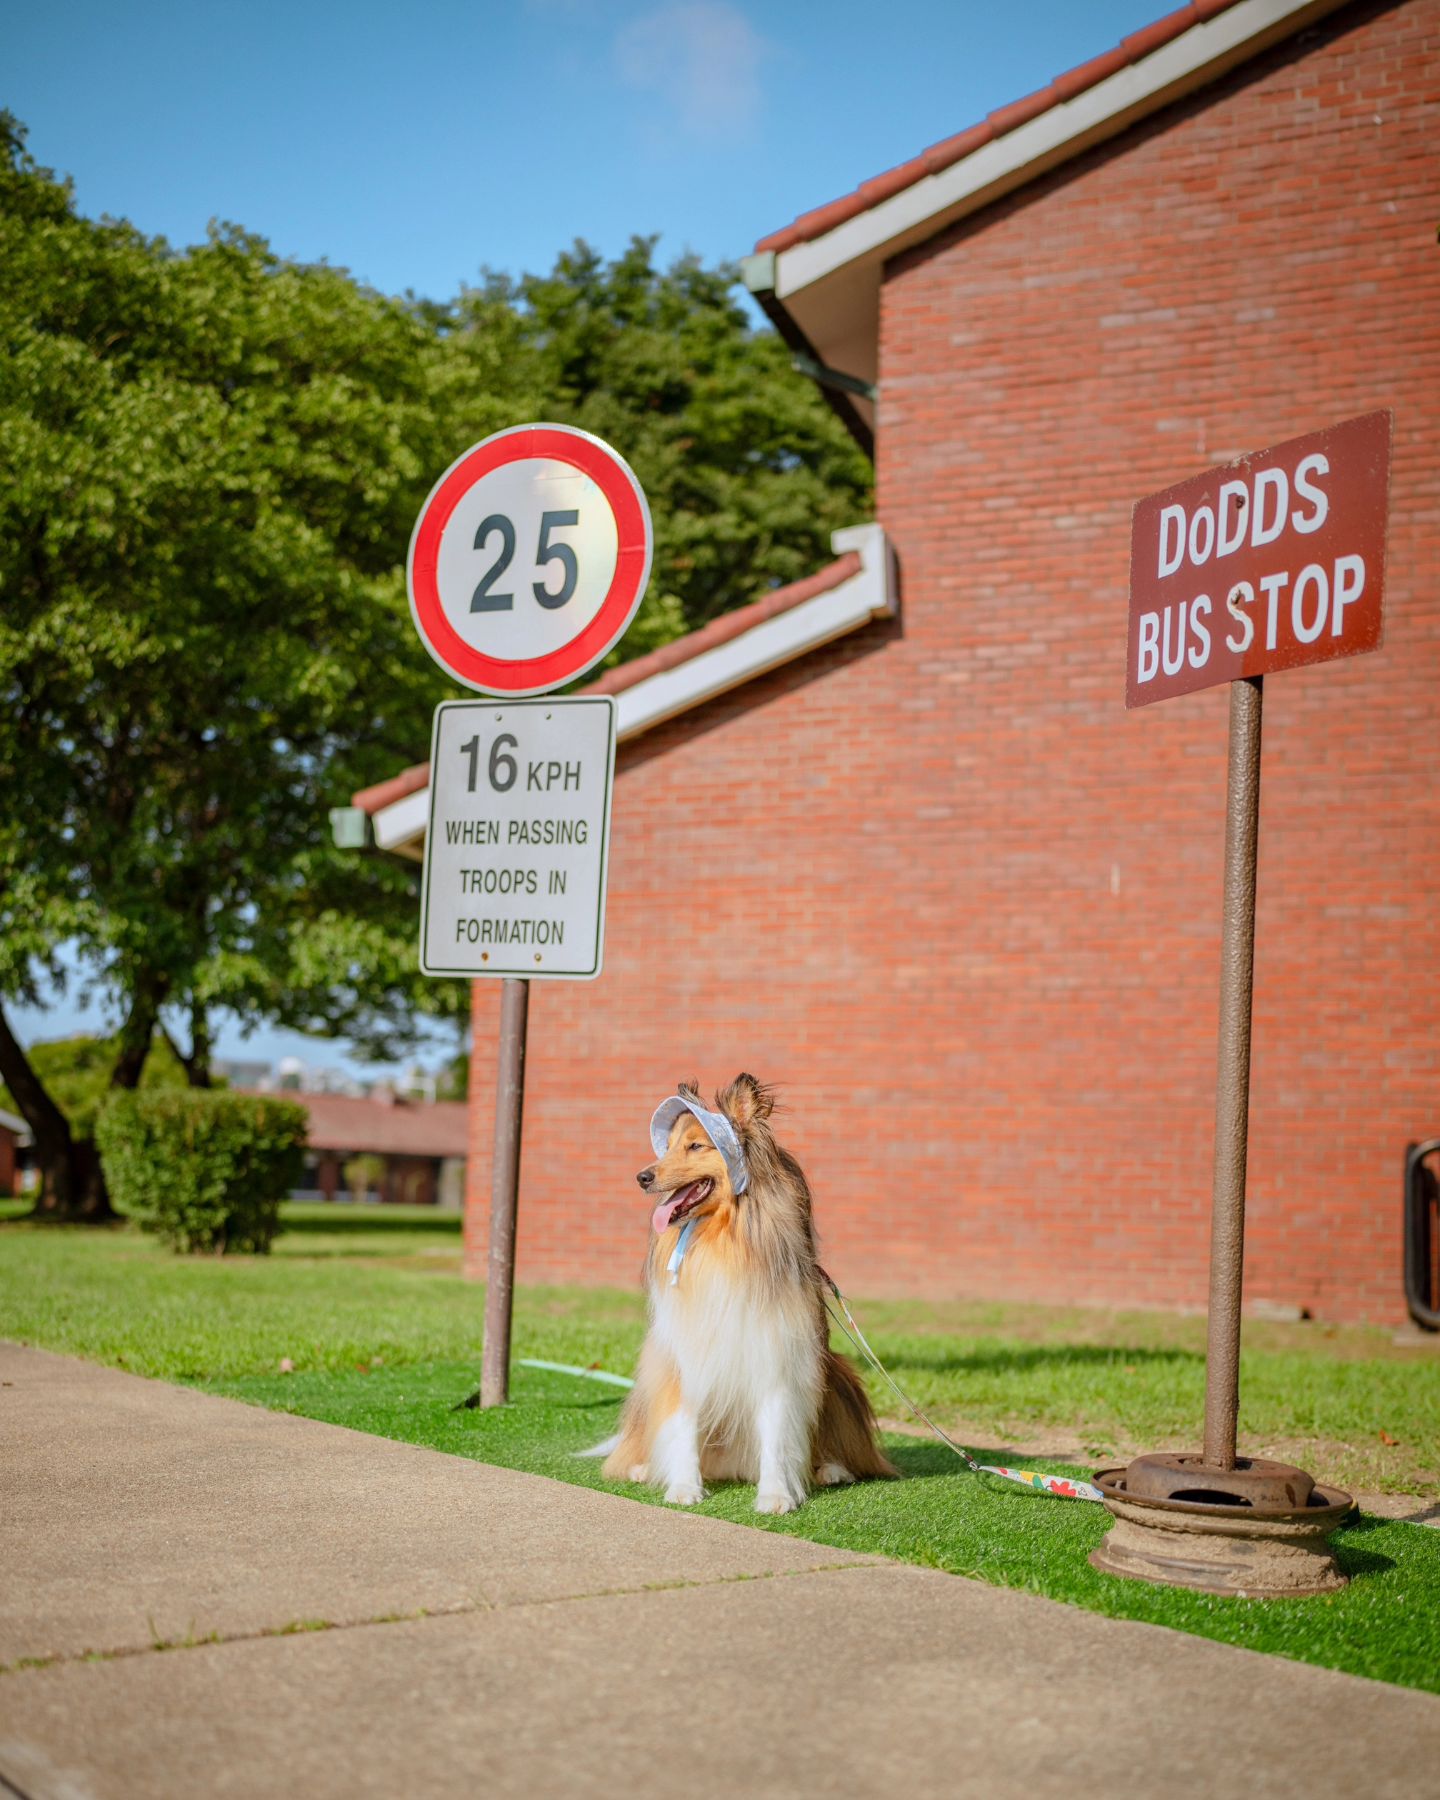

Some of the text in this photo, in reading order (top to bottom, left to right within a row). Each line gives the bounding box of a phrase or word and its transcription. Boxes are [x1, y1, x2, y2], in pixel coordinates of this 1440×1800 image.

[469, 509, 579, 613] 25
[1137, 554, 1366, 684] BUS STOP
[460, 733, 582, 793] 16 KPH
[446, 819, 588, 845] WHEN PASSING
[460, 869, 567, 894] TROOPS IN
[456, 918, 564, 945] FORMATION
